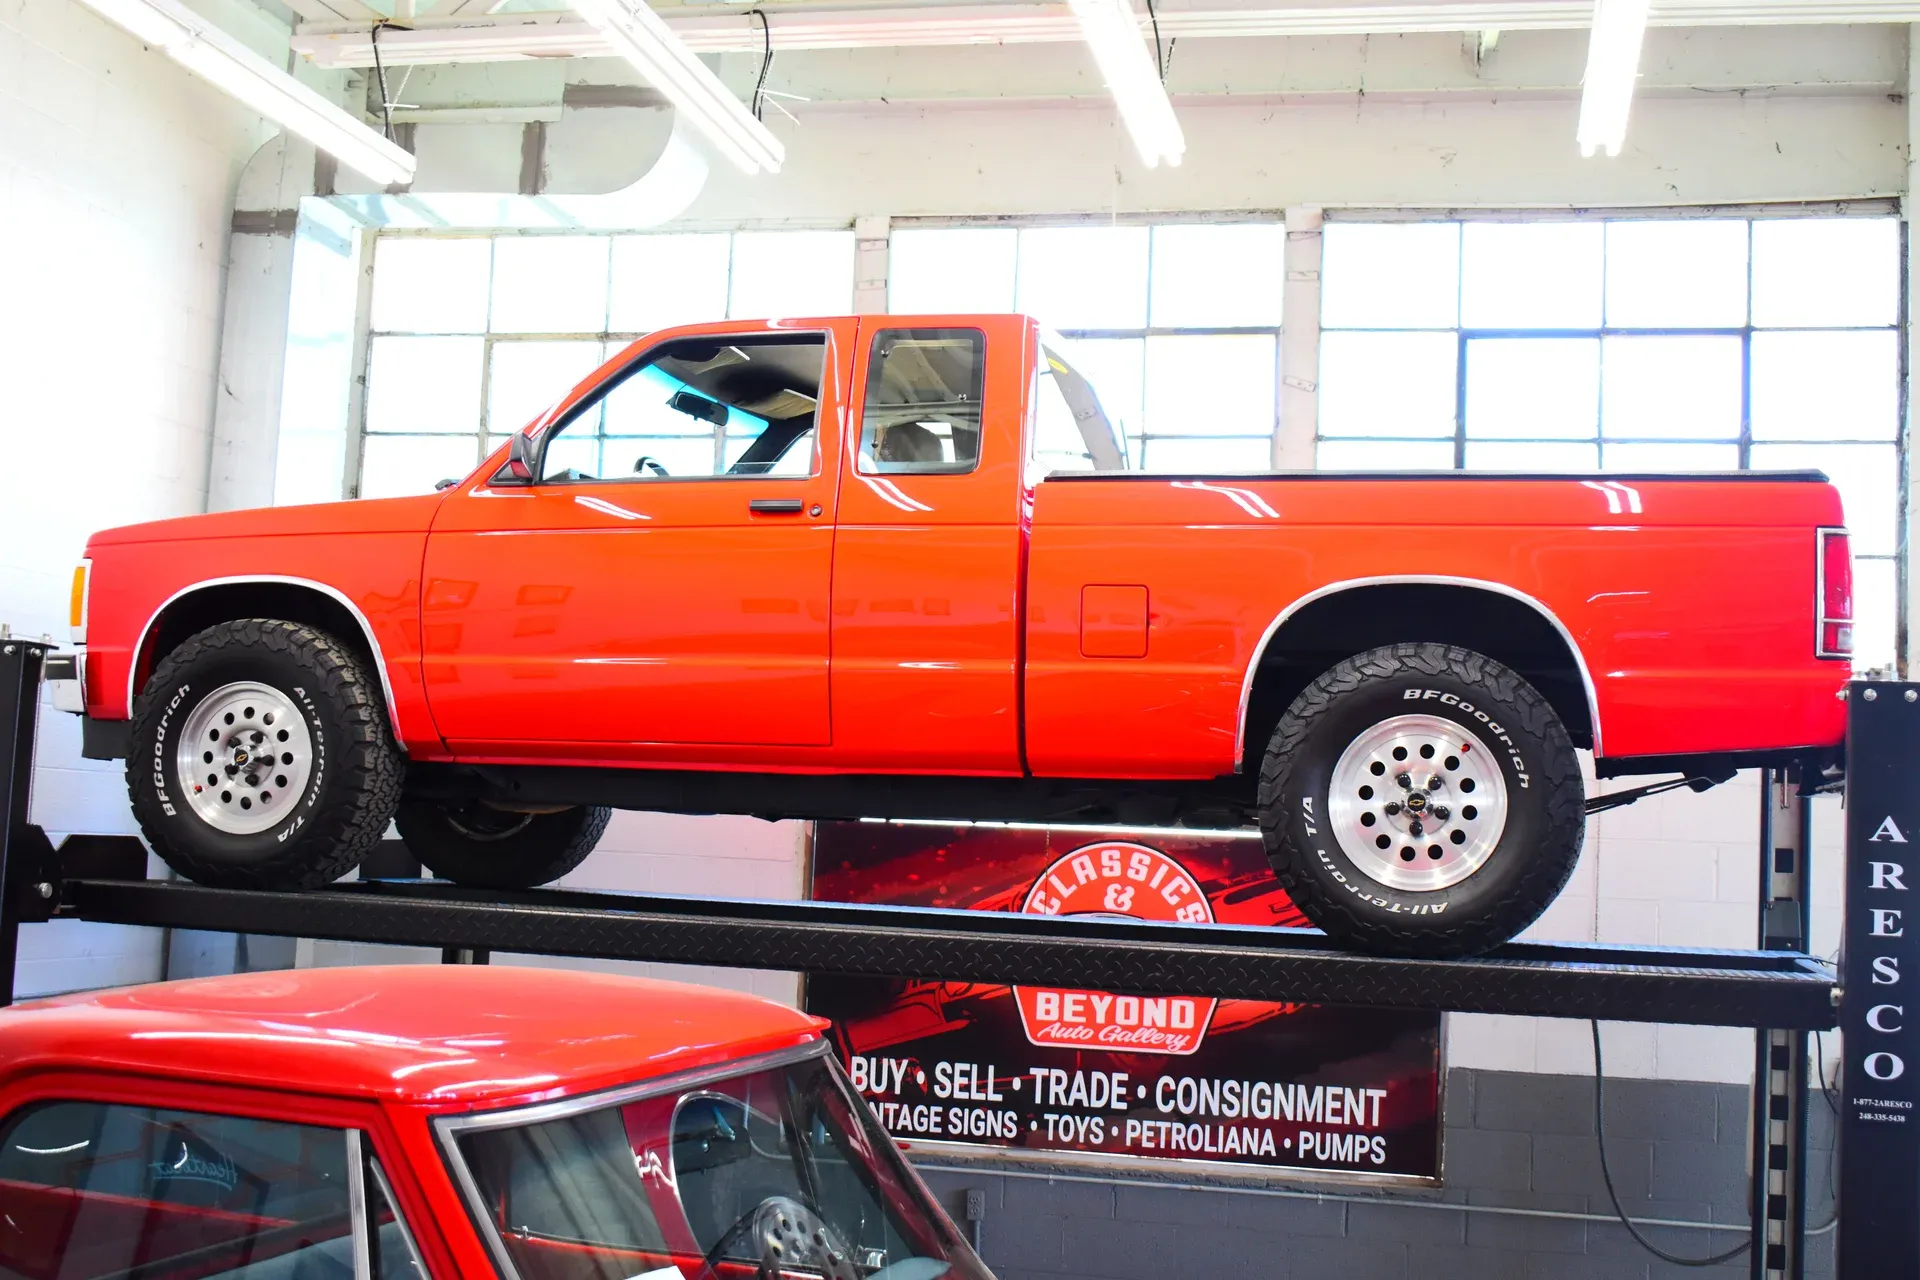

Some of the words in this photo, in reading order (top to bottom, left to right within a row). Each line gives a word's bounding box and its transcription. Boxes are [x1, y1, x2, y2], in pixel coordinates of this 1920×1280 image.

[154, 684, 191, 817] BFGoodrich
[293, 686, 326, 808] All-Terrain
[1403, 688, 1529, 789] BFGoodrich
[277, 815, 305, 843] T/A
[1302, 796, 1317, 838] T/A
[1031, 849, 1207, 923] CLASSICS
[1103, 882, 1136, 912] &
[1318, 849, 1449, 916] All-Terrain
[1863, 815, 1909, 1081] ARESCO
[1036, 991, 1196, 1029] BEYOND
[1037, 1022, 1095, 1039] Auto
[1098, 1024, 1191, 1052] Gallery
[850, 1056, 909, 1095] BUY
[933, 1061, 1003, 1102] SELL
[1029, 1067, 1129, 1110] TRADE
[1155, 1075, 1387, 1127] CONSIGNMENT
[1853, 1098, 1913, 1109] 1-877-2ARESCO
[869, 1101, 943, 1134] NTAGE
[948, 1107, 1018, 1139] SIGNS
[1043, 1113, 1105, 1144] TOYS
[1125, 1119, 1277, 1157] PETROLIANA
[1298, 1131, 1387, 1165] PUMPS
